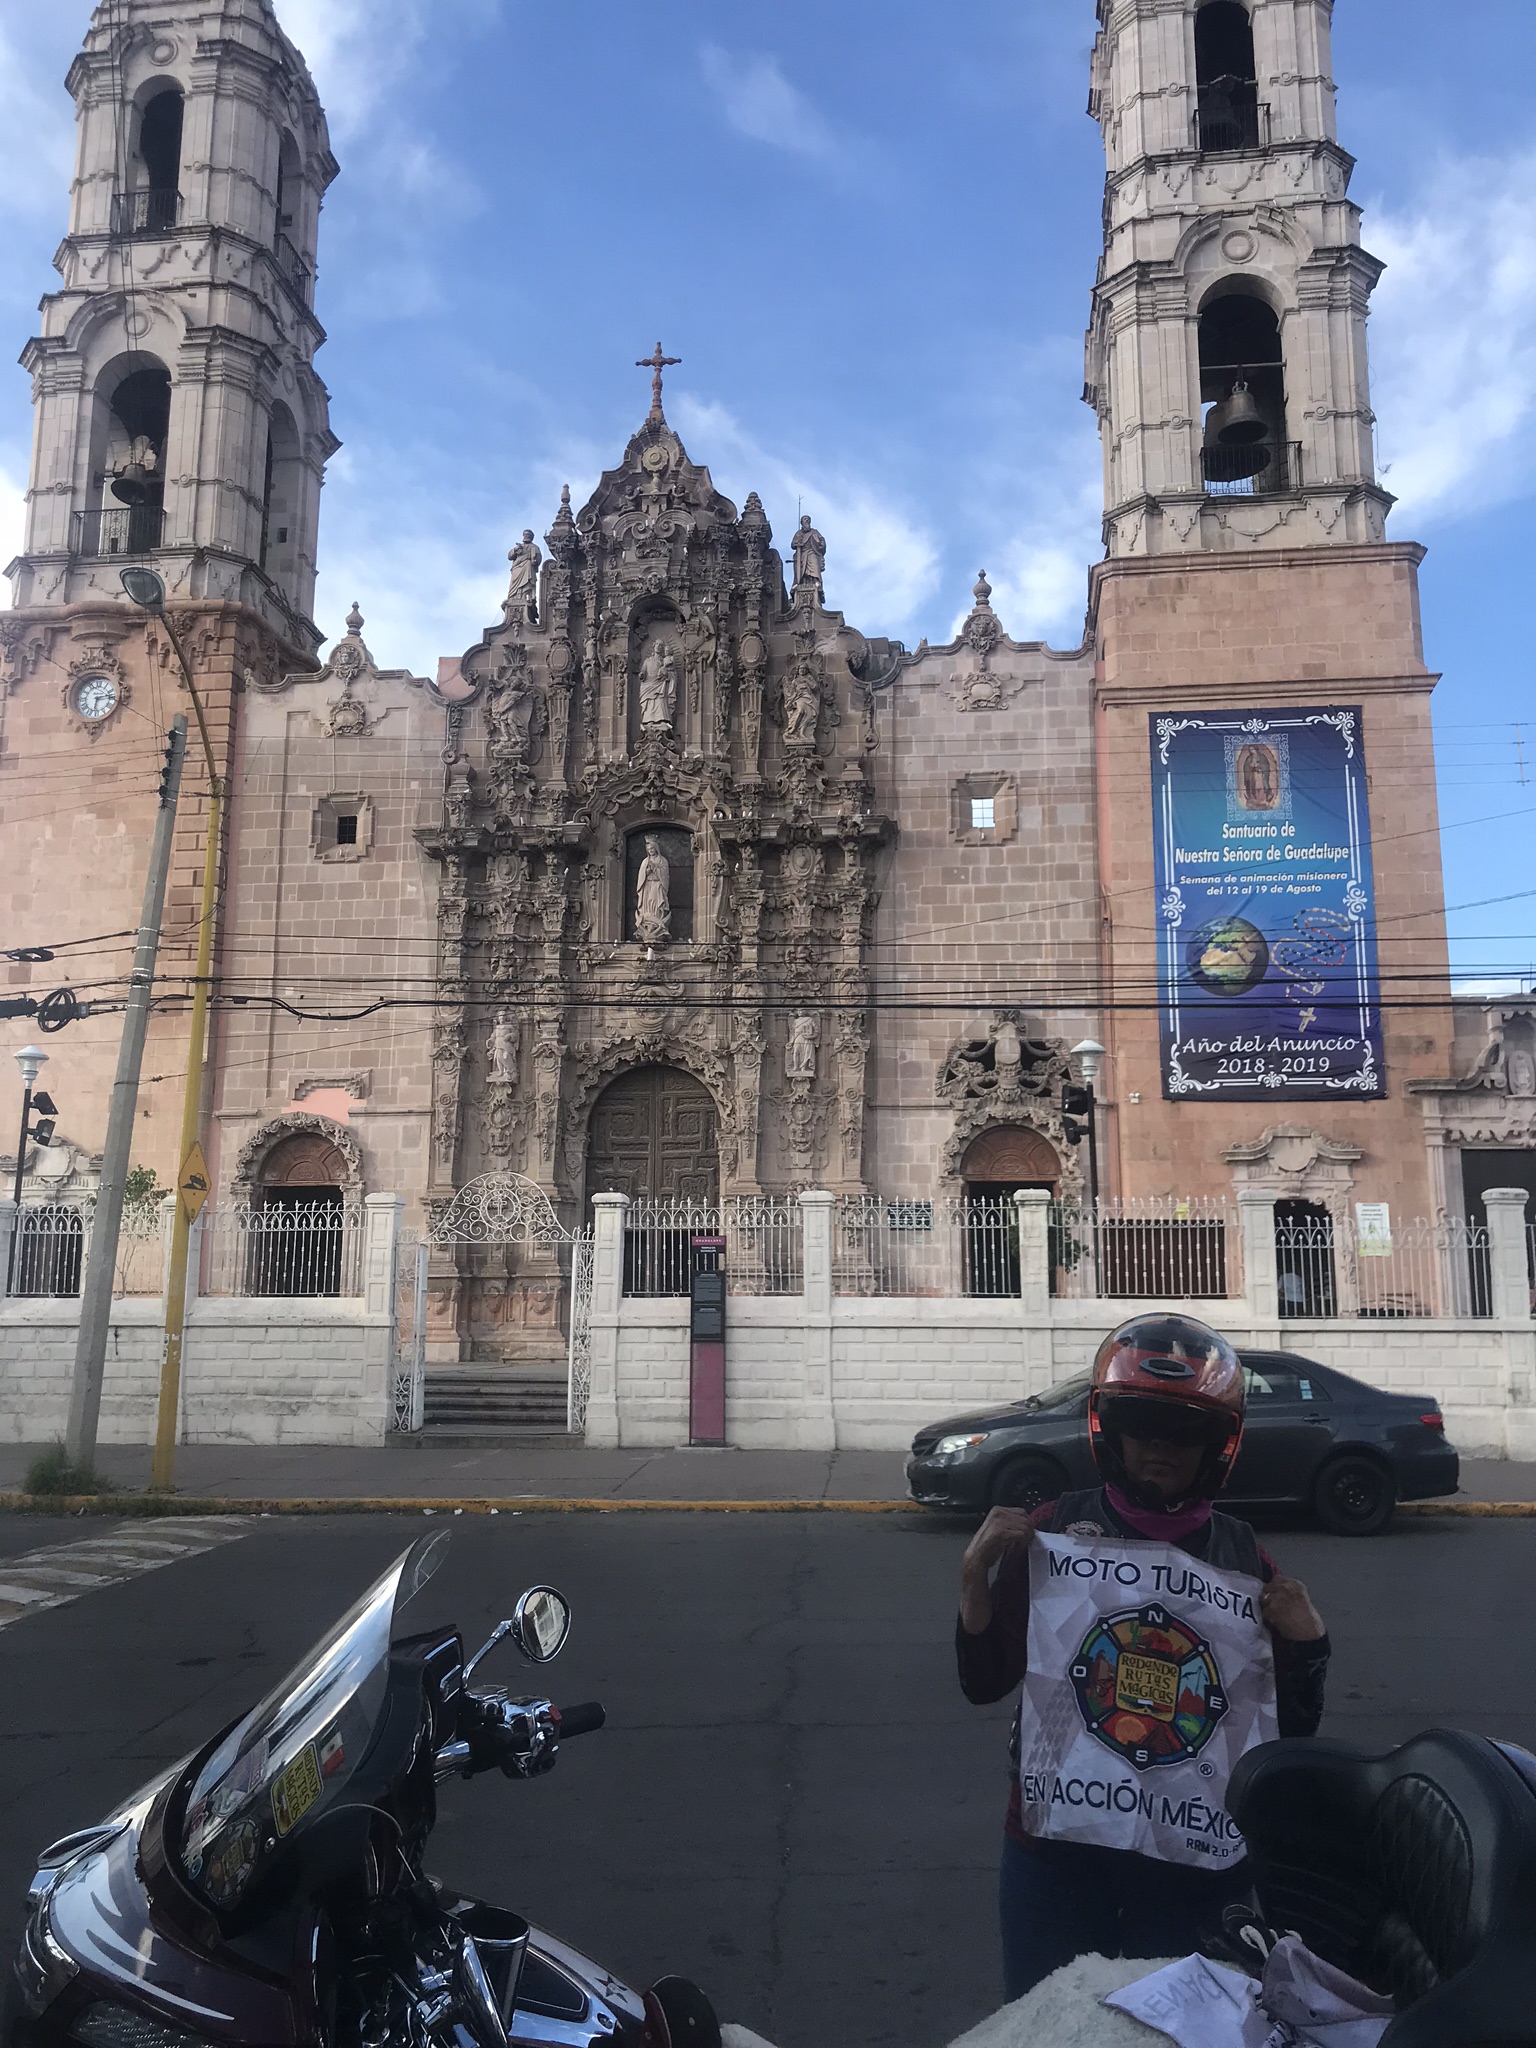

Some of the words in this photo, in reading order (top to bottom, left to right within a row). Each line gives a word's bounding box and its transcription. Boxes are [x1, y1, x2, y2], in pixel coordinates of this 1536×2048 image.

[1222, 821, 1278, 839] Santuario
[1281, 820, 1296, 837] de
[1175, 847, 1220, 863] Nuestra
[1222, 845, 1263, 862] Señora
[1266, 844, 1281, 861] de
[1284, 842, 1349, 863] Guadalupe
[1180, 875, 1222, 885] Semana
[1224, 873, 1238, 883] de
[1240, 872, 1294, 883] animación
[1296, 871, 1348, 881] misionera
[1206, 885, 1224, 896] del
[1227, 885, 1239, 895] 12
[1241, 884, 1252, 895] al
[1255, 884, 1268, 894] 19
[1270, 884, 1284, 894] de
[1286, 883, 1322, 895] Agosto
[1182, 1037, 1228, 1054] Año
[1229, 1035, 1266, 1053] del
[1281, 1056, 1330, 1073] 2019
[1049, 1550, 1141, 1585] MOTO
[1151, 1564, 1259, 1625] TURISTA
[1148, 1610, 1164, 1623] N
[1210, 1697, 1223, 1709] E
[1136, 1750, 1149, 1763] S
[1024, 1774, 1047, 1802] EN
[1052, 1778, 1154, 1820] ACCIÓN
[1161, 1796, 1243, 1840] MÉXIC
